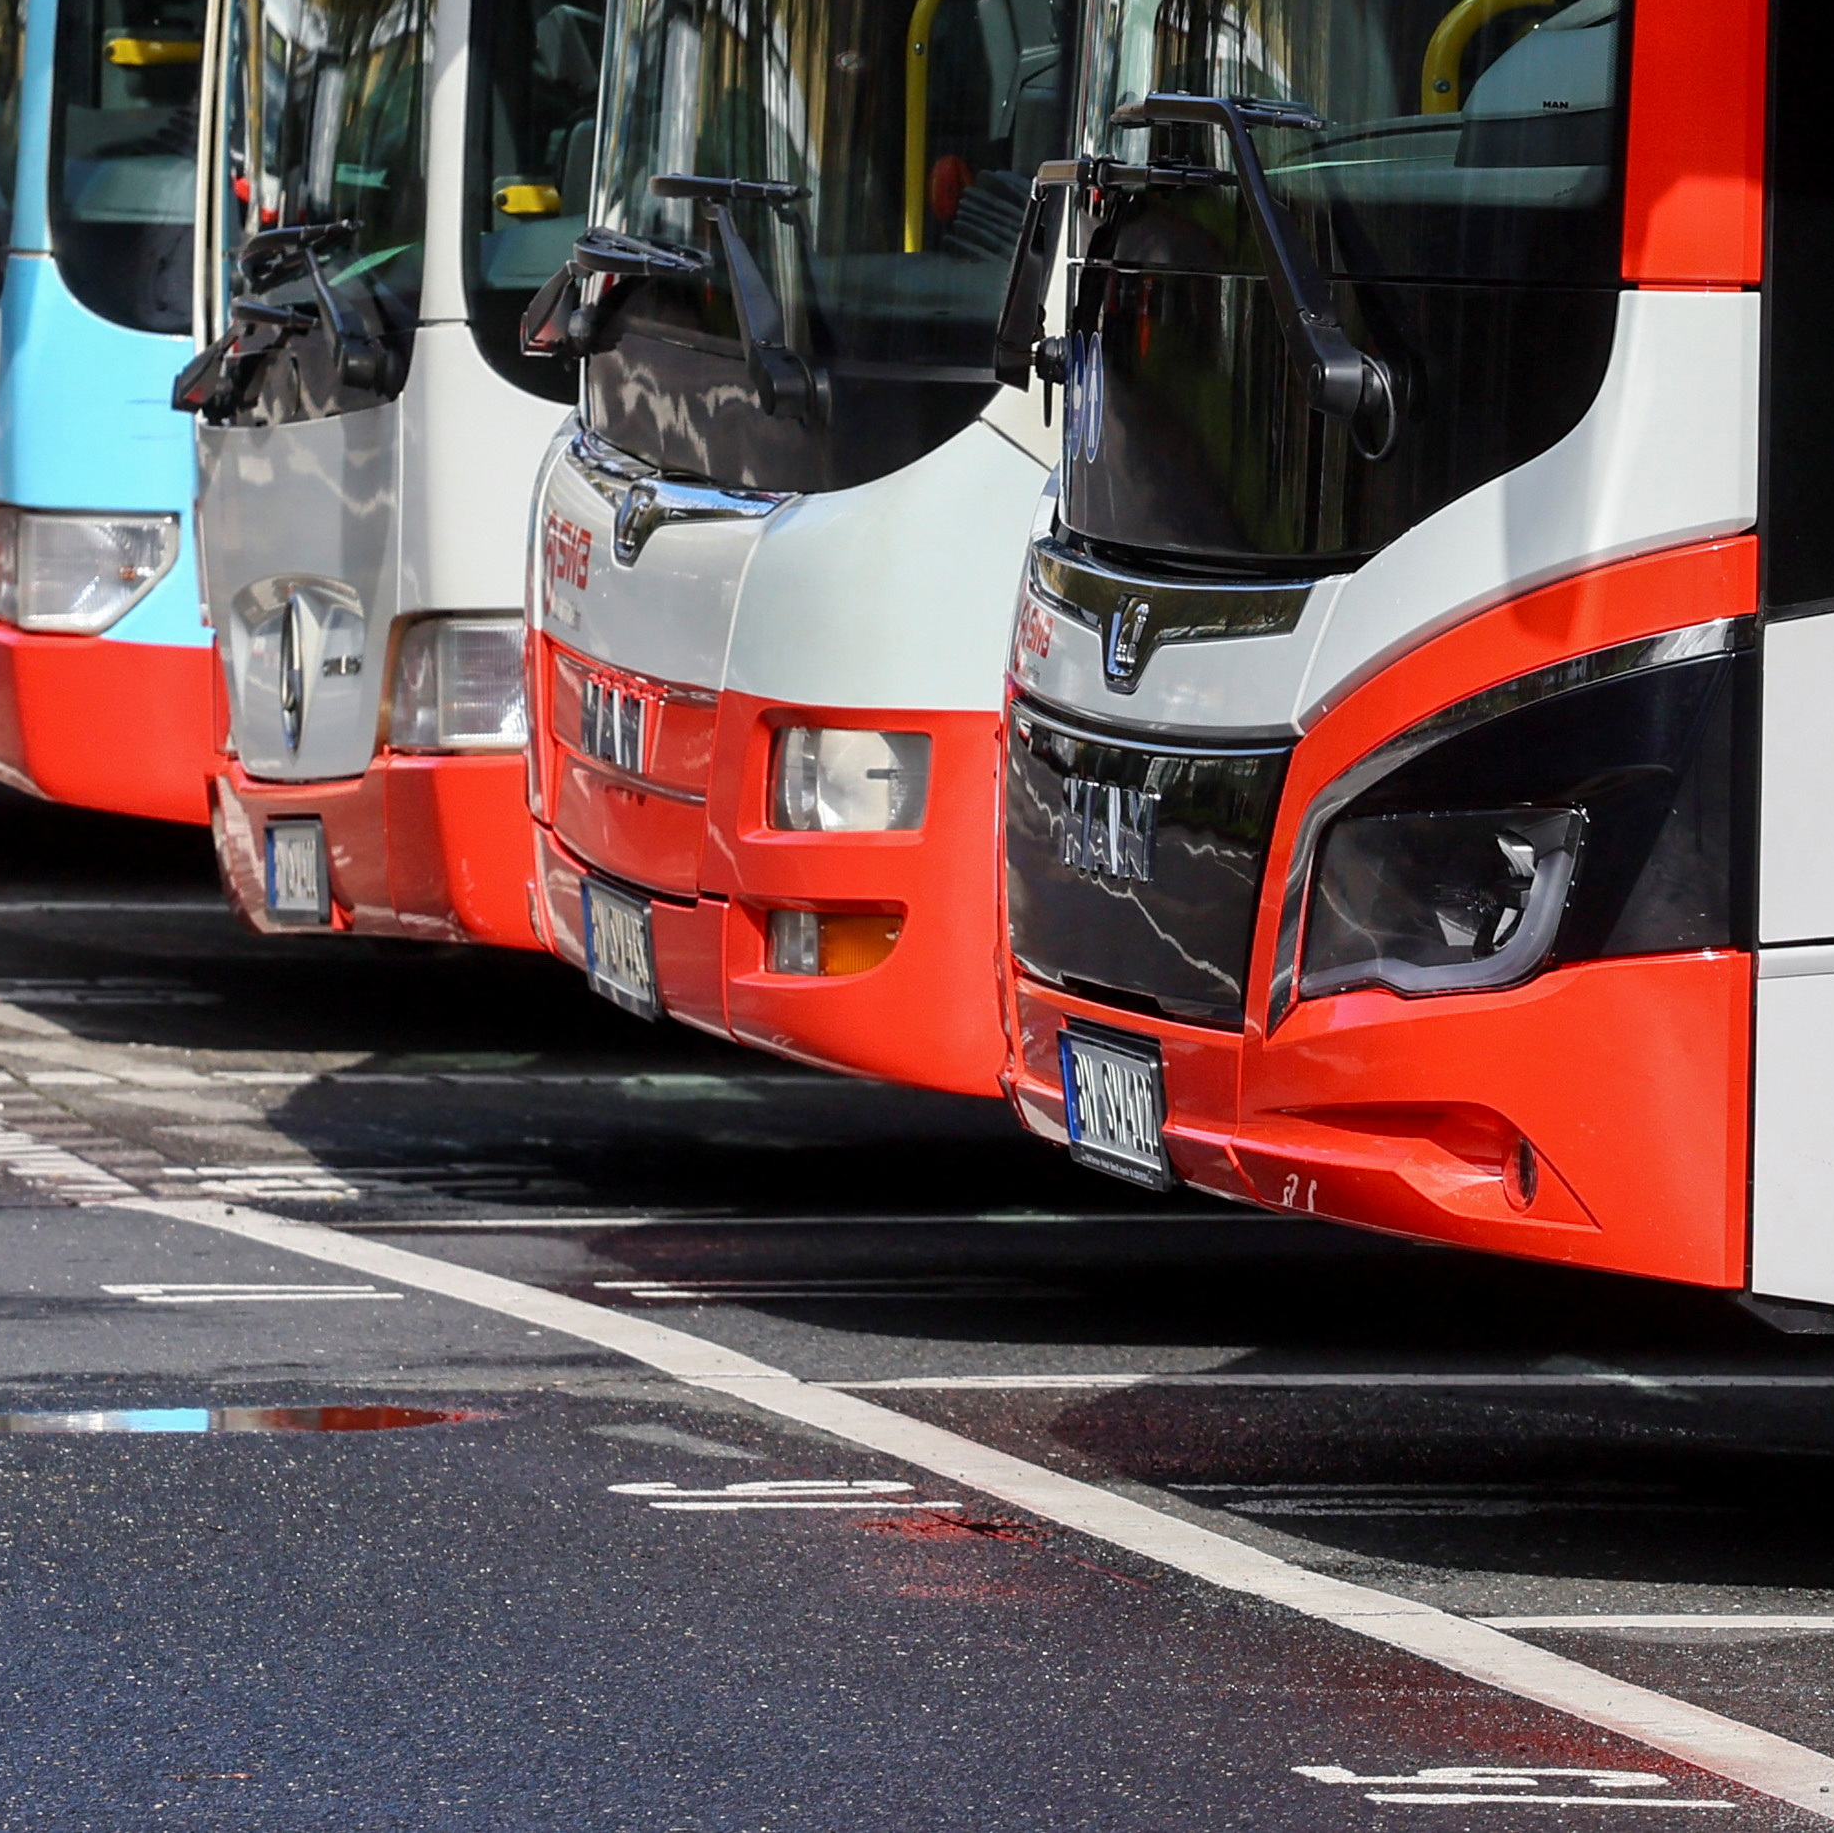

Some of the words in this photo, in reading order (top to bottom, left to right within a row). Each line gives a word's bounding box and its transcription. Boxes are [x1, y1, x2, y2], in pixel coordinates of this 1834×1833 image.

[1543, 101, 1569, 109] MAN
[1073, 1051, 1099, 1137] BN
[1101, 1060, 1127, 1145] SW
